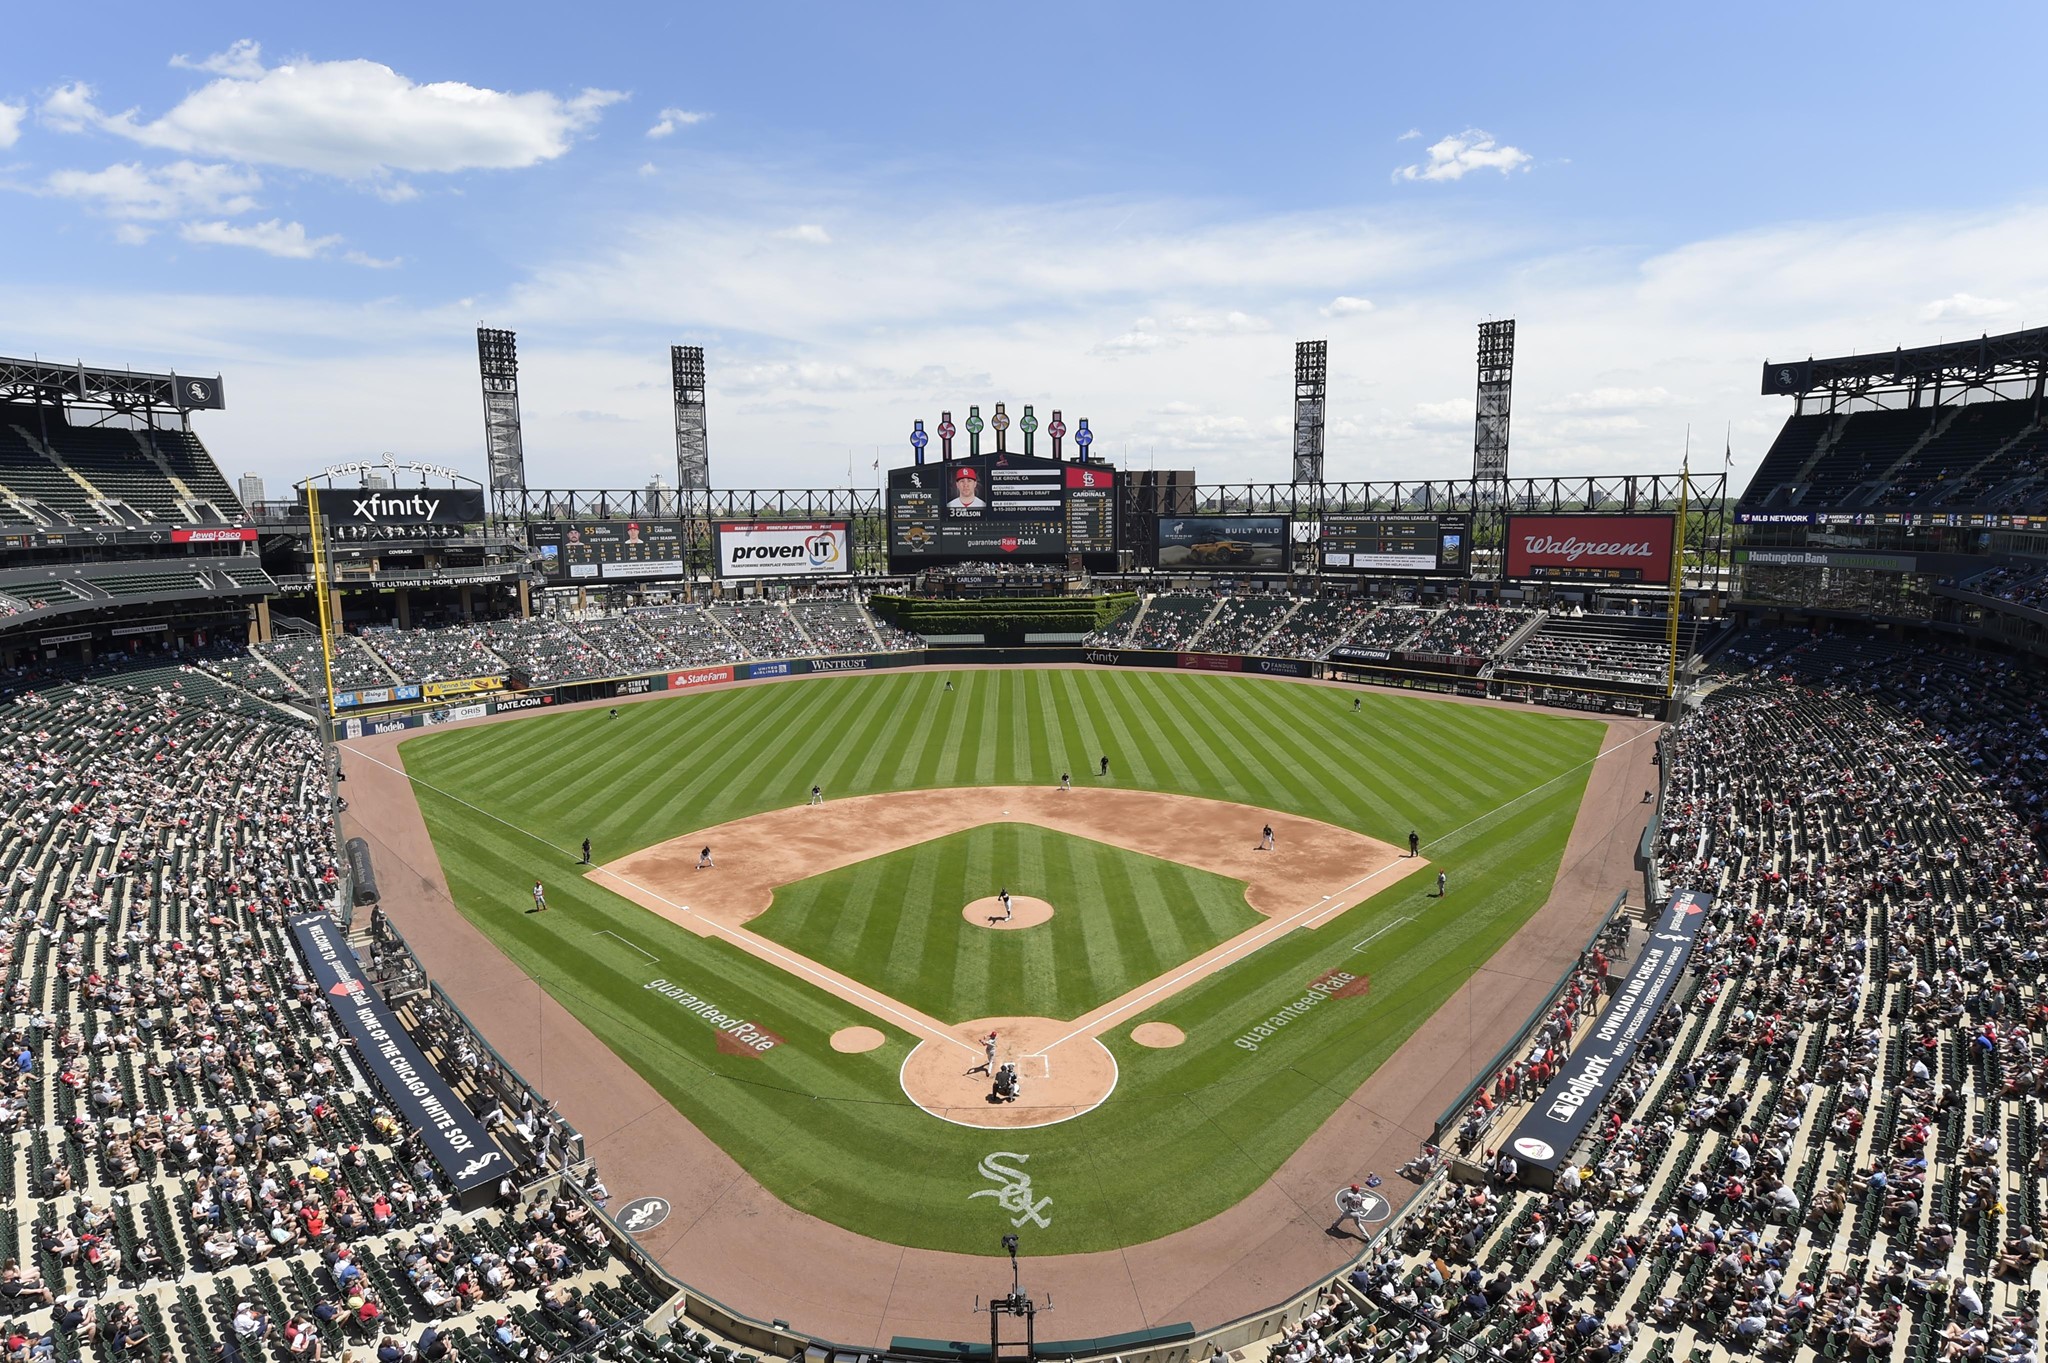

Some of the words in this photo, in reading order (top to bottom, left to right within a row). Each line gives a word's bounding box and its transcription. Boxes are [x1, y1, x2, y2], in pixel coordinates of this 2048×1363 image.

[325, 460, 372, 478] KIDS
[409, 461, 458, 480] ZONE
[352, 493, 439, 521] xfinity
[950, 508, 955, 517] 3
[190, 531, 241, 541] Jewel-Osco
[732, 546, 804, 562] proven
[814, 542, 830, 556] IT
[1524, 535, 1652, 562] Walgreens
[1749, 552, 1804, 564] Huntington
[1805, 553, 1828, 564] Bank
[470, 575, 501, 584] EXPERIENCE
[281, 584, 302, 592] xfinity
[1086, 651, 1119, 664] xfinity
[1352, 650, 1386, 658] HYUNDAI
[1404, 653, 1447, 664] WHITTINGHAM
[812, 660, 866, 670] WINTRUST
[437, 682, 459, 690] Vienna
[628, 679, 650, 687] STREAM
[628, 686, 642, 694] YOUR
[497, 697, 541, 711] RATE.COM
[1548, 700, 1582, 710] CHICAGO'S
[461, 707, 481, 716] ORIS
[375, 721, 404, 734] Modelo
[308, 924, 333, 952] WELCOME
[322, 951, 337, 960] TO
[1596, 994, 1636, 1041] DOWNLOAD
[1626, 979, 1646, 997] AND
[1636, 948, 1664, 981] CHECK-IN
[356, 1008, 378, 1030] HOME
[370, 1030, 387, 1042] OF
[1612, 1039, 1628, 1057] MAPS
[1623, 1003, 1649, 1039] CONCESSIONS
[378, 1039, 400, 1059] THE
[390, 1054, 430, 1097] CHICAGO
[419, 1095, 456, 1130] WHITE
[444, 1128, 474, 1153] SOX
